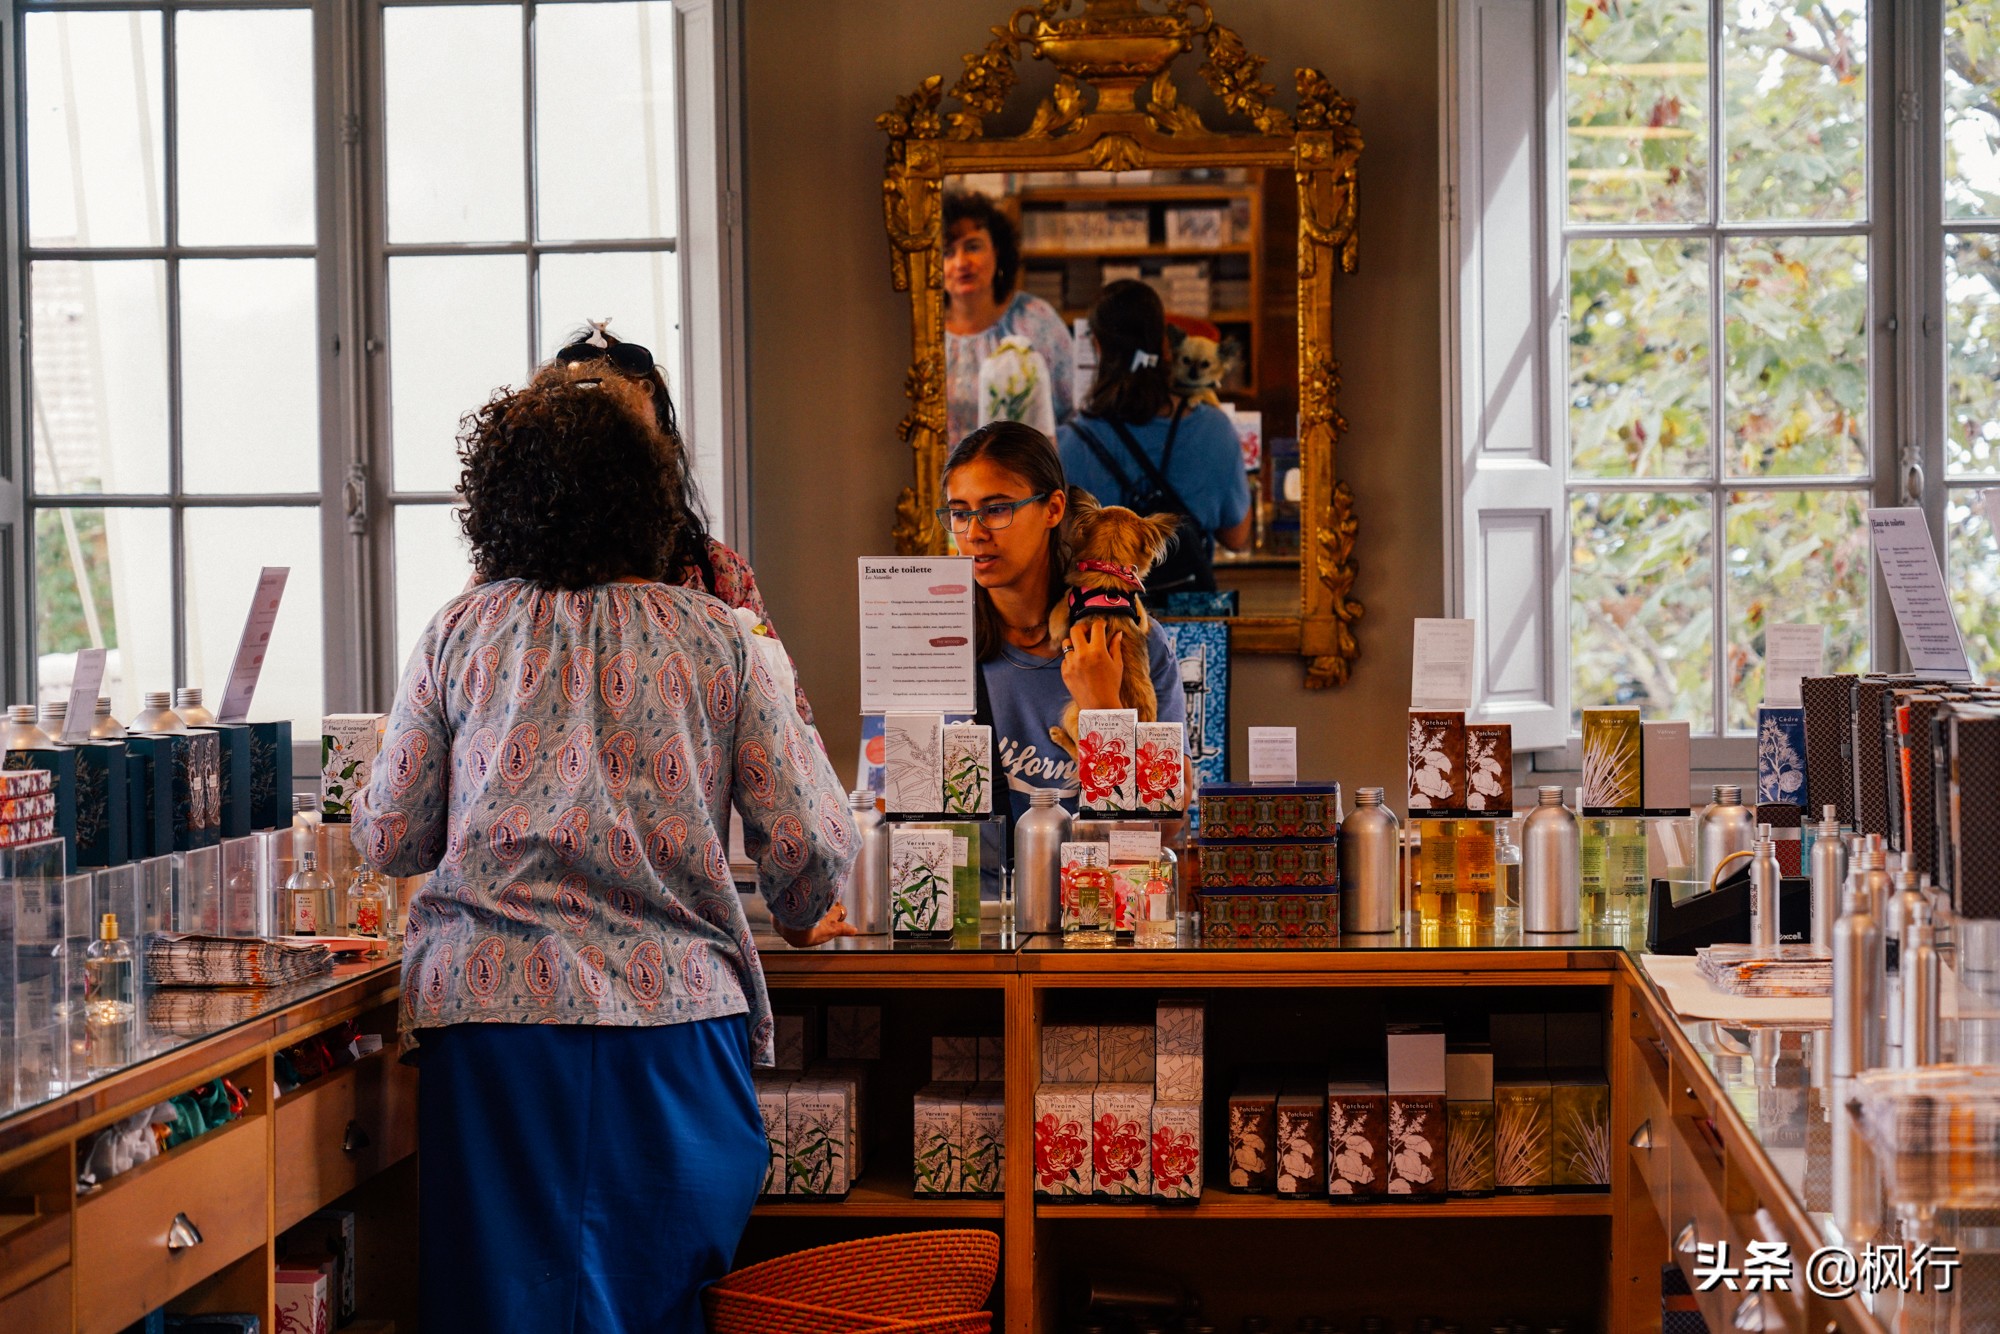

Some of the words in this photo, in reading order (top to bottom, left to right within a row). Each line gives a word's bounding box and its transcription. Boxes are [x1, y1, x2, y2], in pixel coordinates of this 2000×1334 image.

[865, 566, 887, 574] Eaux
[889, 566, 900, 574] de
[901, 566, 932, 574] toilette
